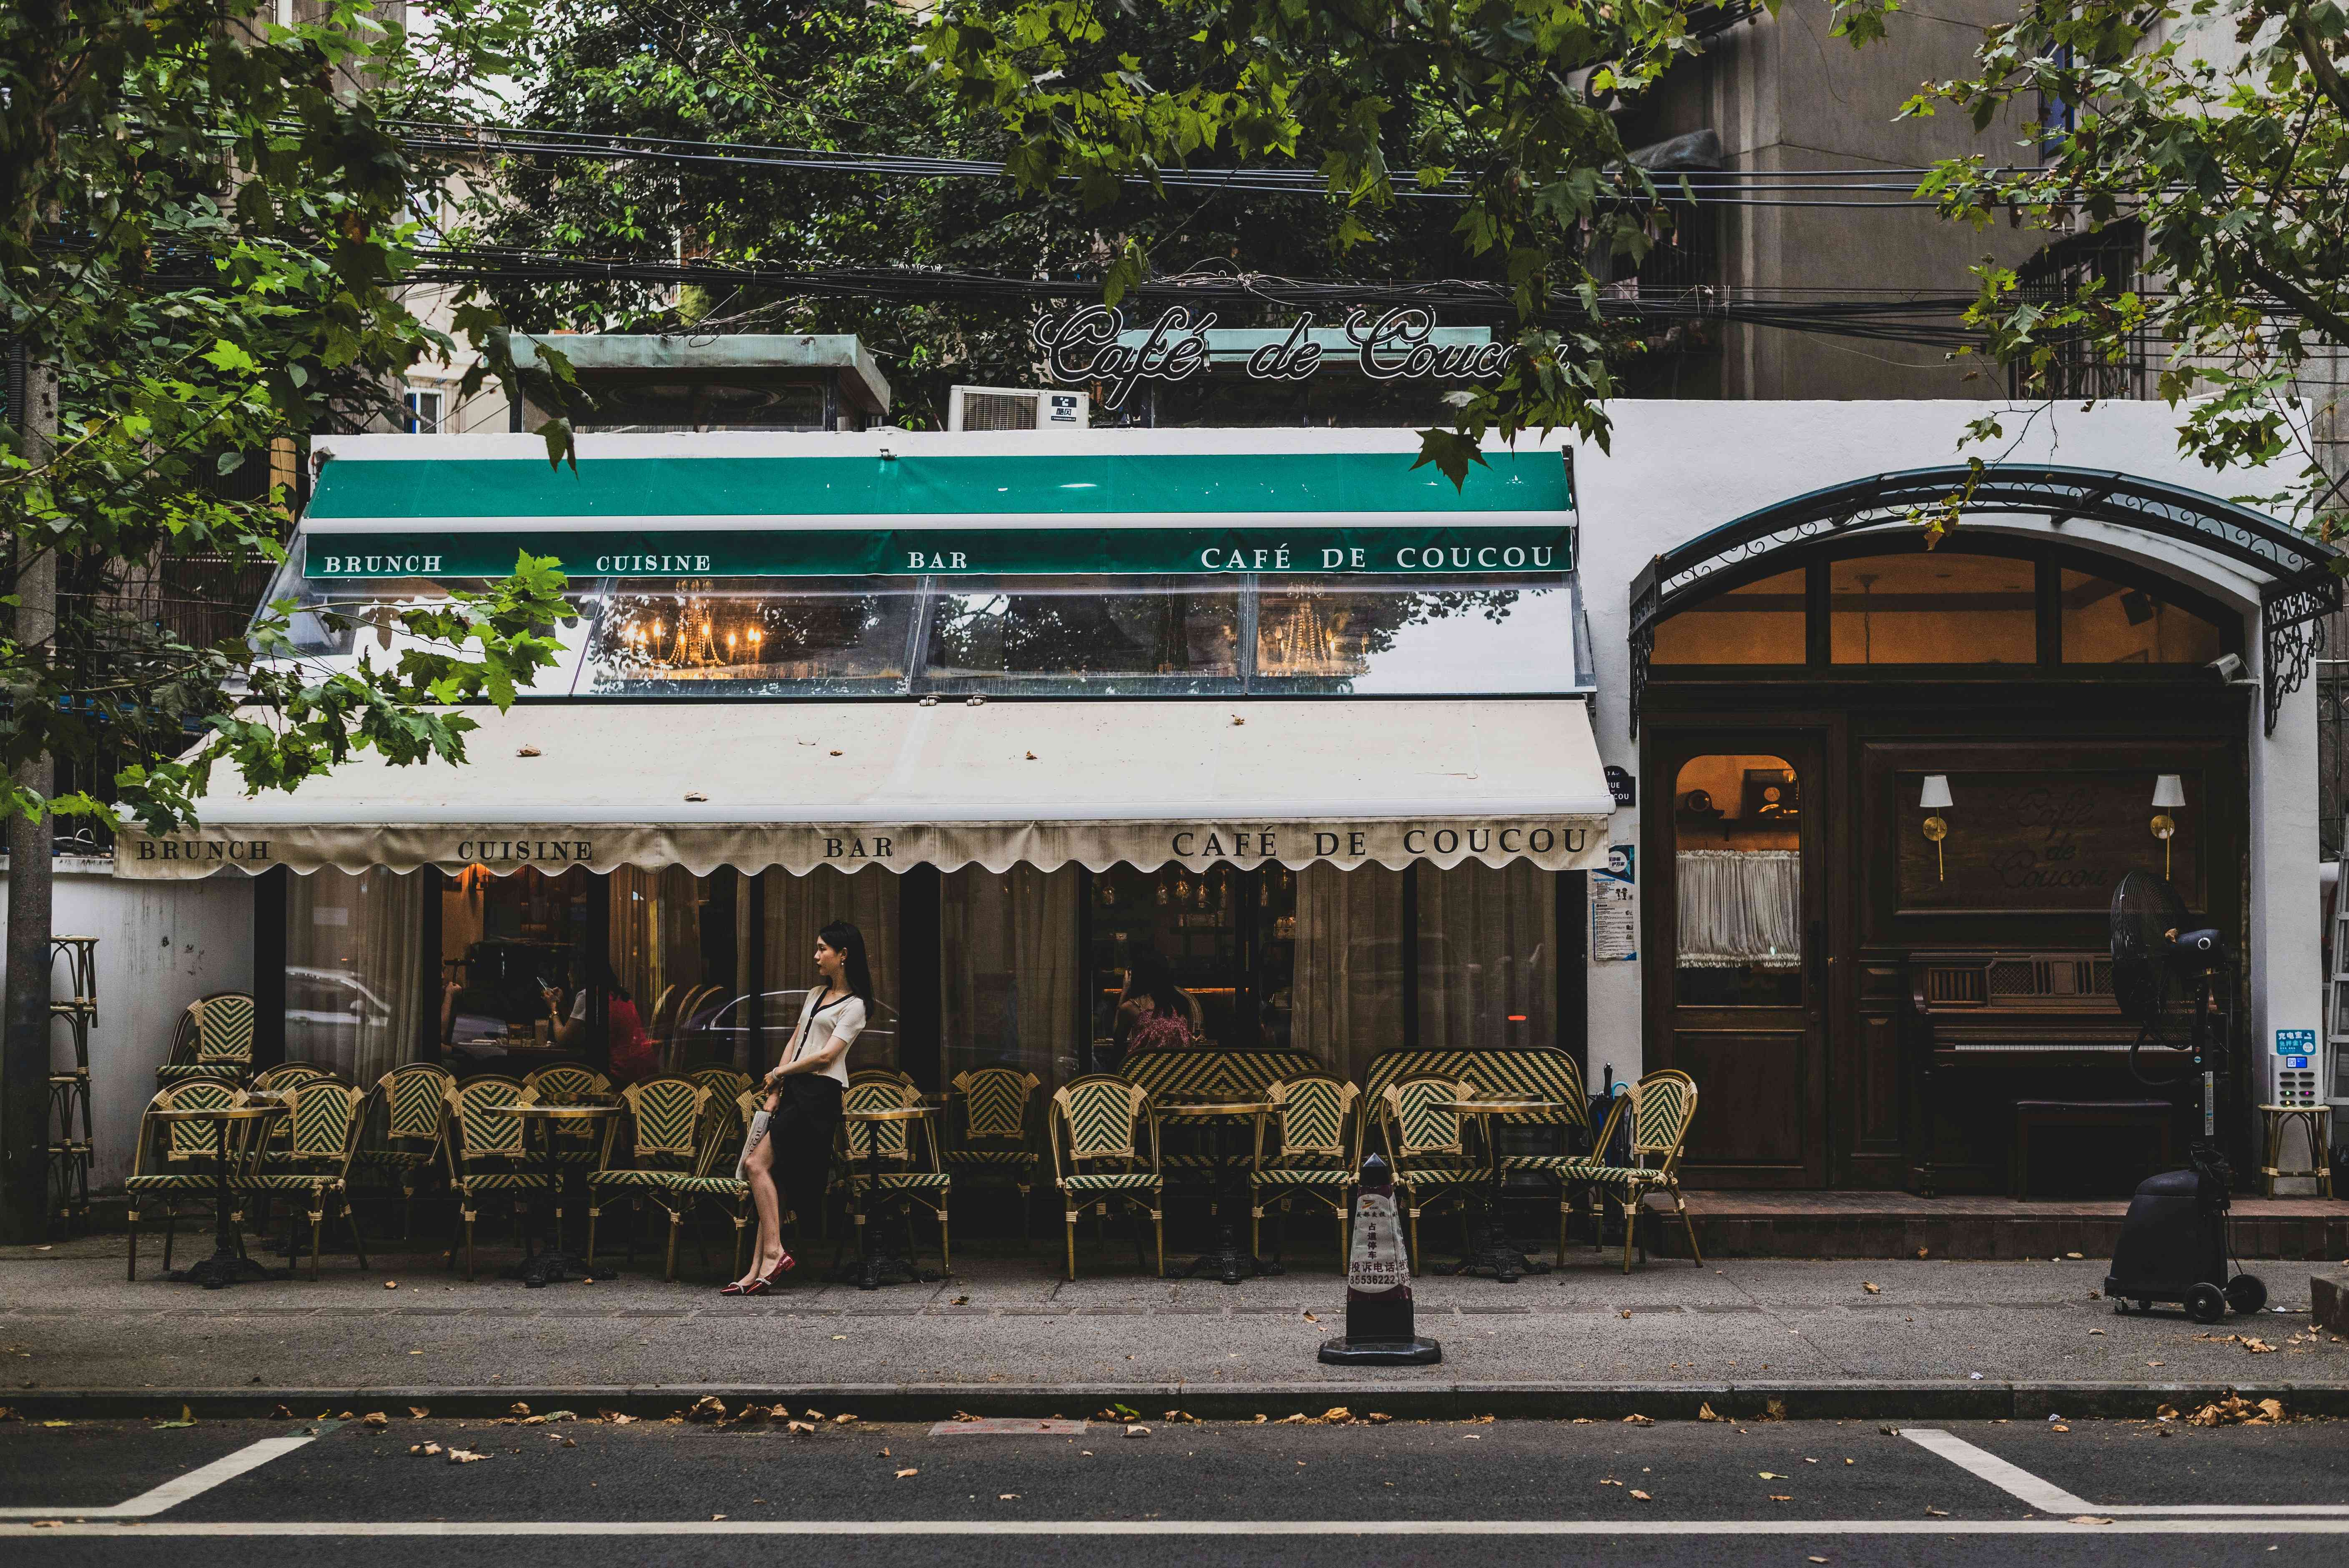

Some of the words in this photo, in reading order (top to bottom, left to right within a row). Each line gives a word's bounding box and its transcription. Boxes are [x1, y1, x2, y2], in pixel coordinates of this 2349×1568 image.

[1033, 305, 1217, 410] Café
[1247, 311, 1321, 380] de
[323, 555, 442, 572] BRUNCH
[596, 555, 710, 571] CUISINE
[907, 552, 967, 569] BAR
[1201, 543, 1290, 569] CAFÉ
[1322, 548, 1365, 568] DE
[1397, 547, 1553, 568] COUCOU
[136, 840, 271, 860] BRUNCH
[457, 840, 593, 860] CUISINE
[823, 838, 893, 858] BAR
[1172, 826, 1277, 857] CAFÉ
[1314, 832, 1366, 856] DE
[1403, 828, 1587, 854] COUCOU
[2046, 833, 2075, 861] de
[1991, 850, 2108, 888] Coucou
[1368, 1222, 1377, 1259] 占道停车
[1351, 1262, 1395, 1273] 投诉电话
[1350, 1275, 1395, 1285] 85536222
